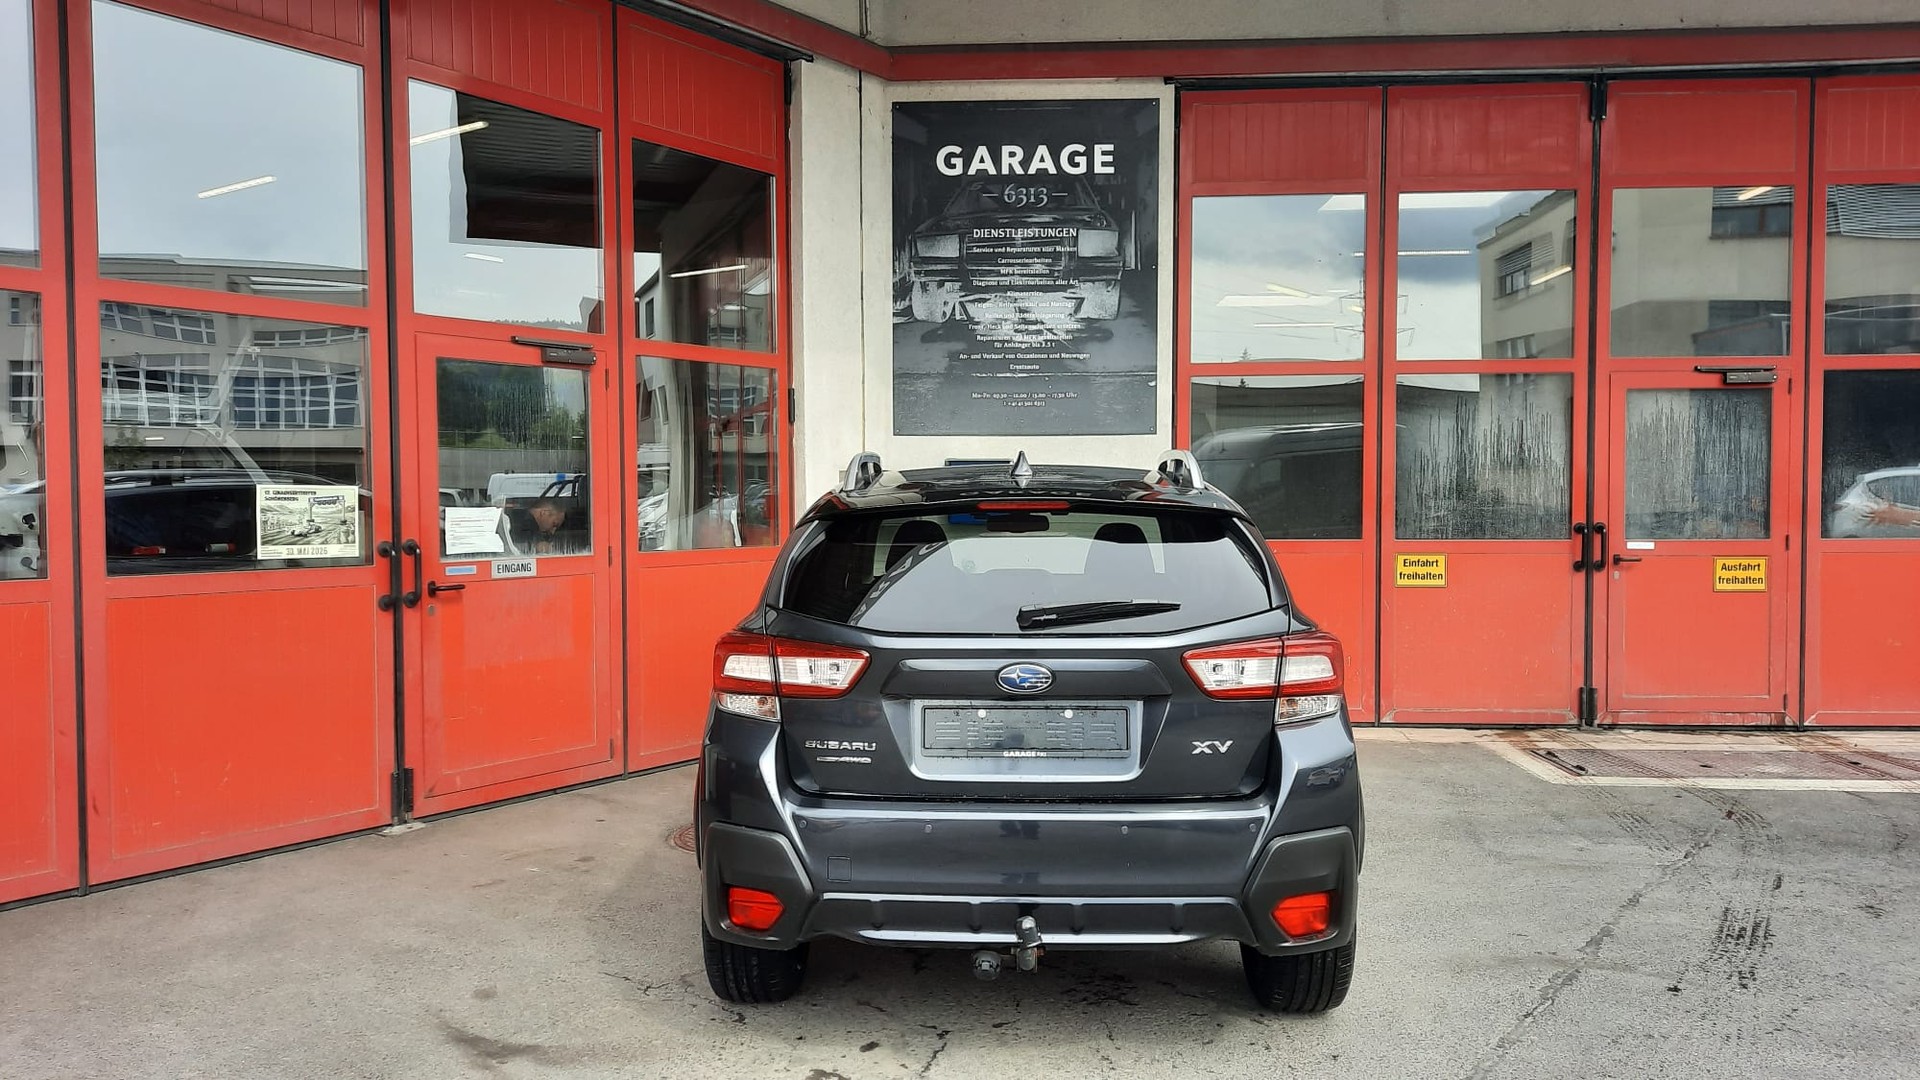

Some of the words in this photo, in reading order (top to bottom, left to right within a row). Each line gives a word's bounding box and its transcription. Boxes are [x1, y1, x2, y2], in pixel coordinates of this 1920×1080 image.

[936, 144, 1115, 176] GARAGE
[1003, 183, 1048, 208] 6313
[973, 228, 1077, 238] DIENSTLEISTUNGEN
[1403, 558, 1439, 567] Einfahrt
[1720, 562, 1761, 572] Ausfahrt
[496, 563, 532, 574] EINGANG
[1399, 571, 1443, 580] freihalten
[1718, 576, 1763, 585] freihalten
[805, 740, 877, 751] SUBARU
[1191, 740, 1234, 754] XV
